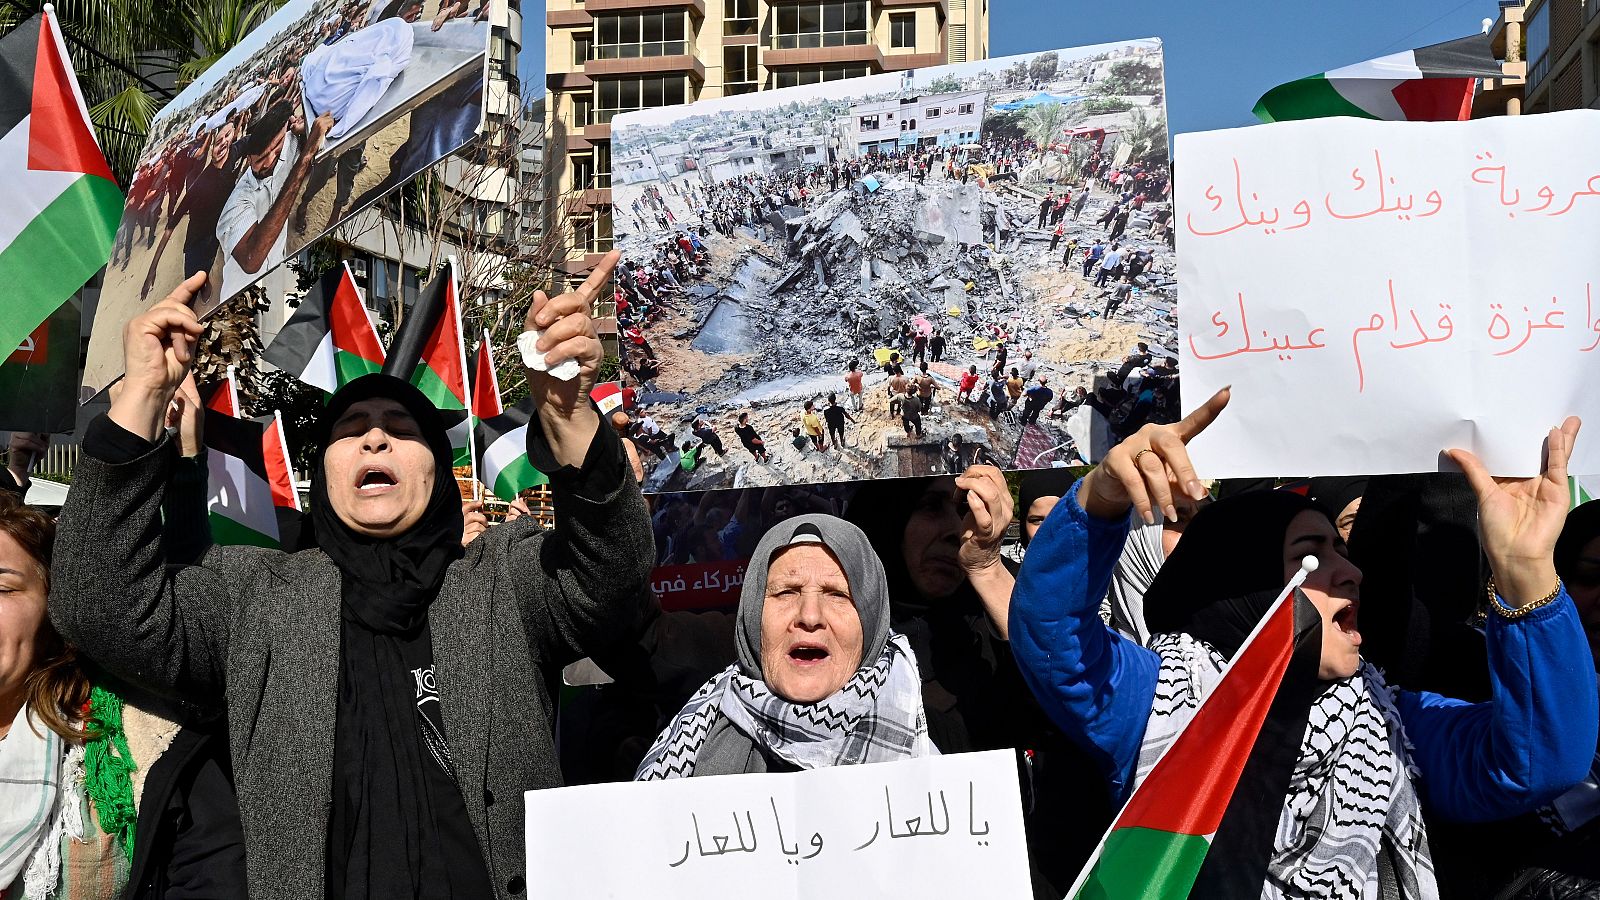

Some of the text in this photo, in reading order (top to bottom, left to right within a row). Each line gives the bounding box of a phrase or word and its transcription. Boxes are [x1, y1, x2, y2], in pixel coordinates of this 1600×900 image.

[1187, 158, 1311, 236] وينك
[1325, 150, 1442, 220] وينك
[1189, 292, 1326, 361] عينك
[1353, 279, 1454, 392] قدام
[1488, 296, 1565, 355] غزة
[651, 574, 686, 598] في
[668, 781, 990, 868] يا للعار ويا للعار
